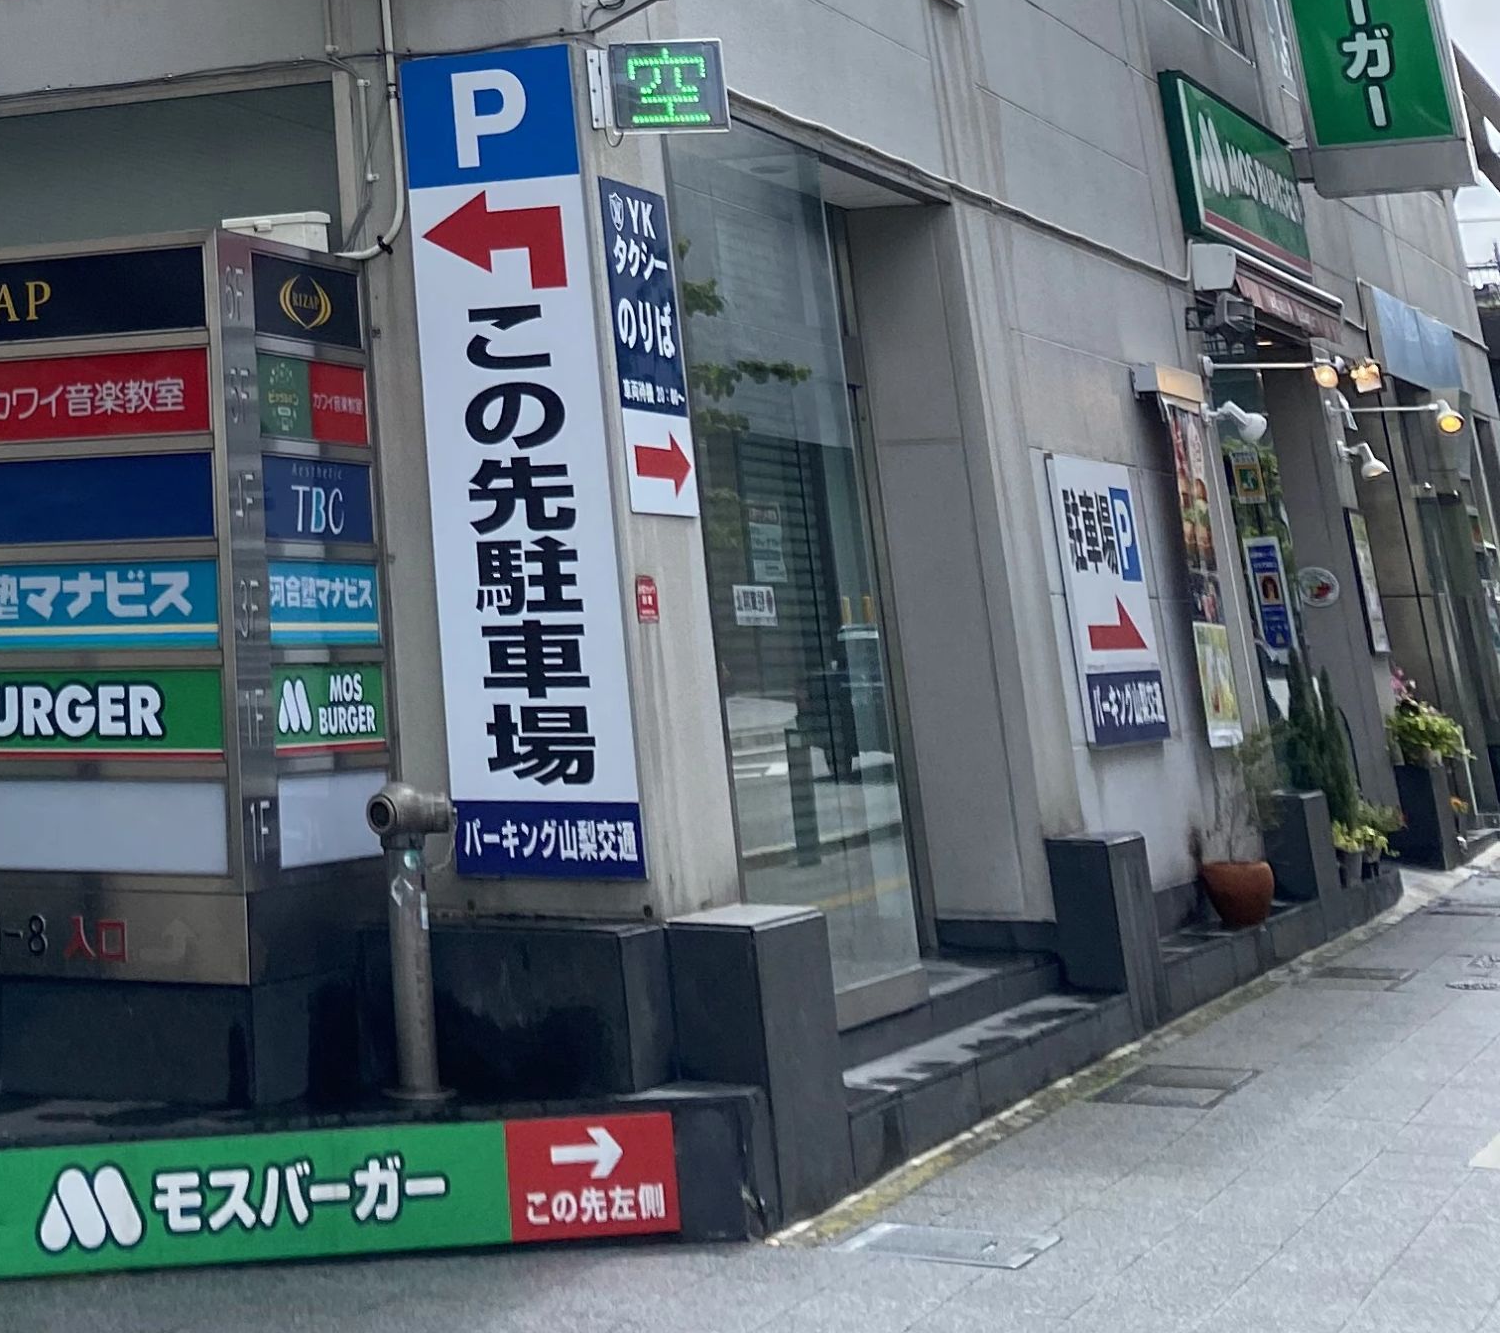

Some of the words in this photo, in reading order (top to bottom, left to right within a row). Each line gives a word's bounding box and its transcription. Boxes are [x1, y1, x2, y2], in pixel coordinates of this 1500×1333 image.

[626, 47, 711, 124] 空
[451, 68, 527, 169] P
[626, 196, 657, 240] YK
[613, 234, 669, 281] タクシー
[291, 292, 320, 311] RIZAP
[618, 297, 677, 359] のりば
[290, 485, 345, 535] TBC
[1061, 486, 1120, 576] 駐車場
[463, 303, 598, 787] この先駐車場
[269, 575, 373, 610] 河合塾マナビス
[329, 672, 363, 704] MOS
[318, 704, 377, 736] BURGER
[250, 799, 271, 864] 1F
[464, 816, 640, 865] パーキング山梨交通
[63, 915, 128, 963] 入口
[153, 1155, 447, 1232] モスバーガー
[525, 1183, 667, 1227] この先左側
